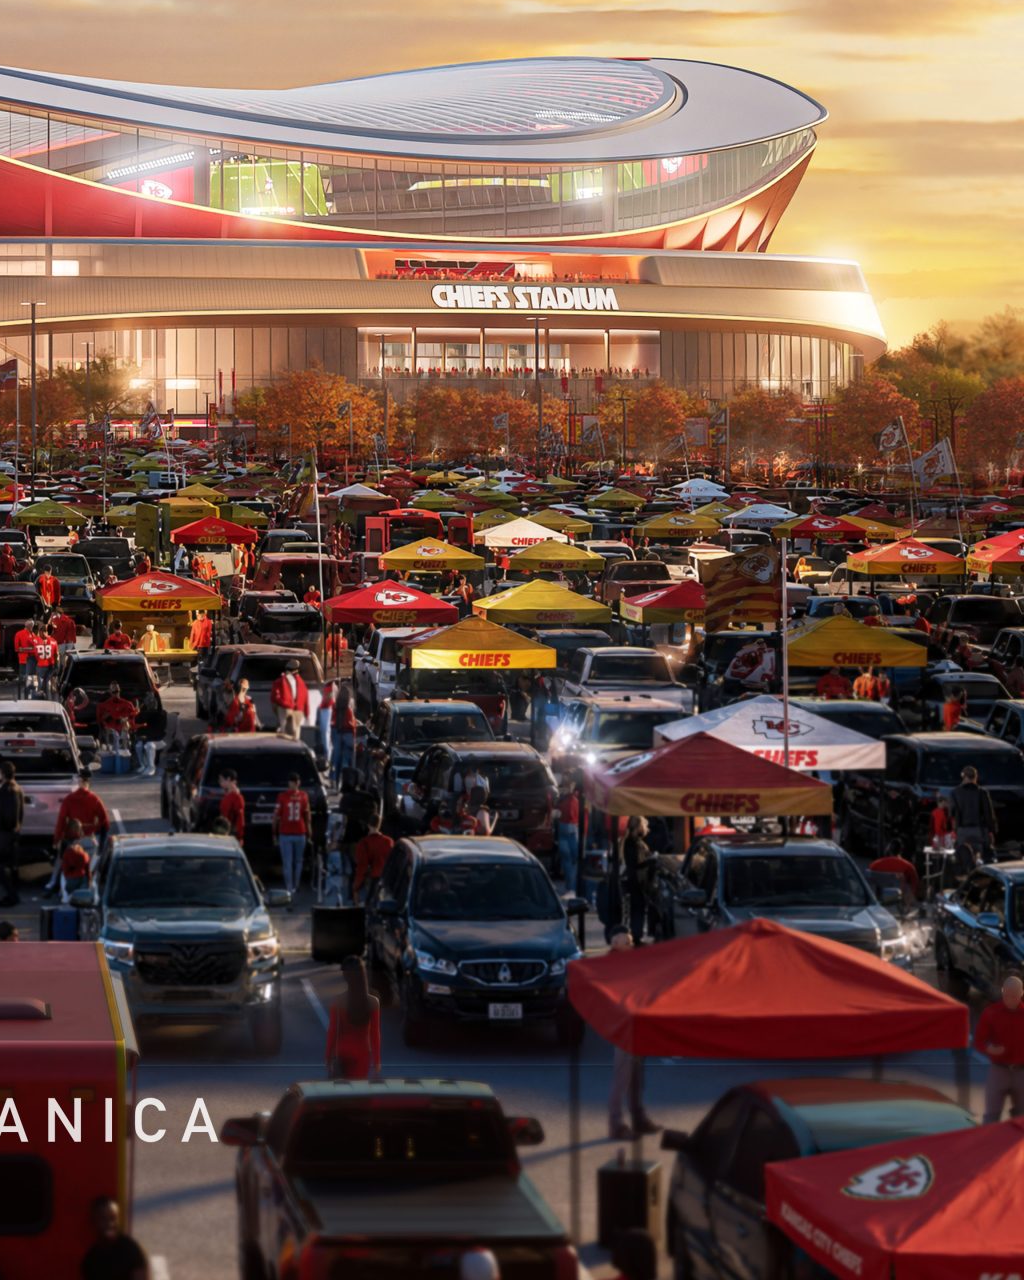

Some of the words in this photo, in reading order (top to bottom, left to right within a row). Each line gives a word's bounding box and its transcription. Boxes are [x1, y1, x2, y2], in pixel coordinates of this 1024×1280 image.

[431, 284, 511, 310] CHIEFS
[512, 286, 619, 311] STADIUM
[900, 563, 937, 573] CHIEFS
[139, 599, 182, 610] CHIEFS
[372, 610, 417, 622] CHIEFS
[36, 644, 52, 660] 99
[832, 652, 882, 665] CHIEFS
[458, 653, 511, 667] CHIEFS
[679, 792, 760, 814] CHIEFS
